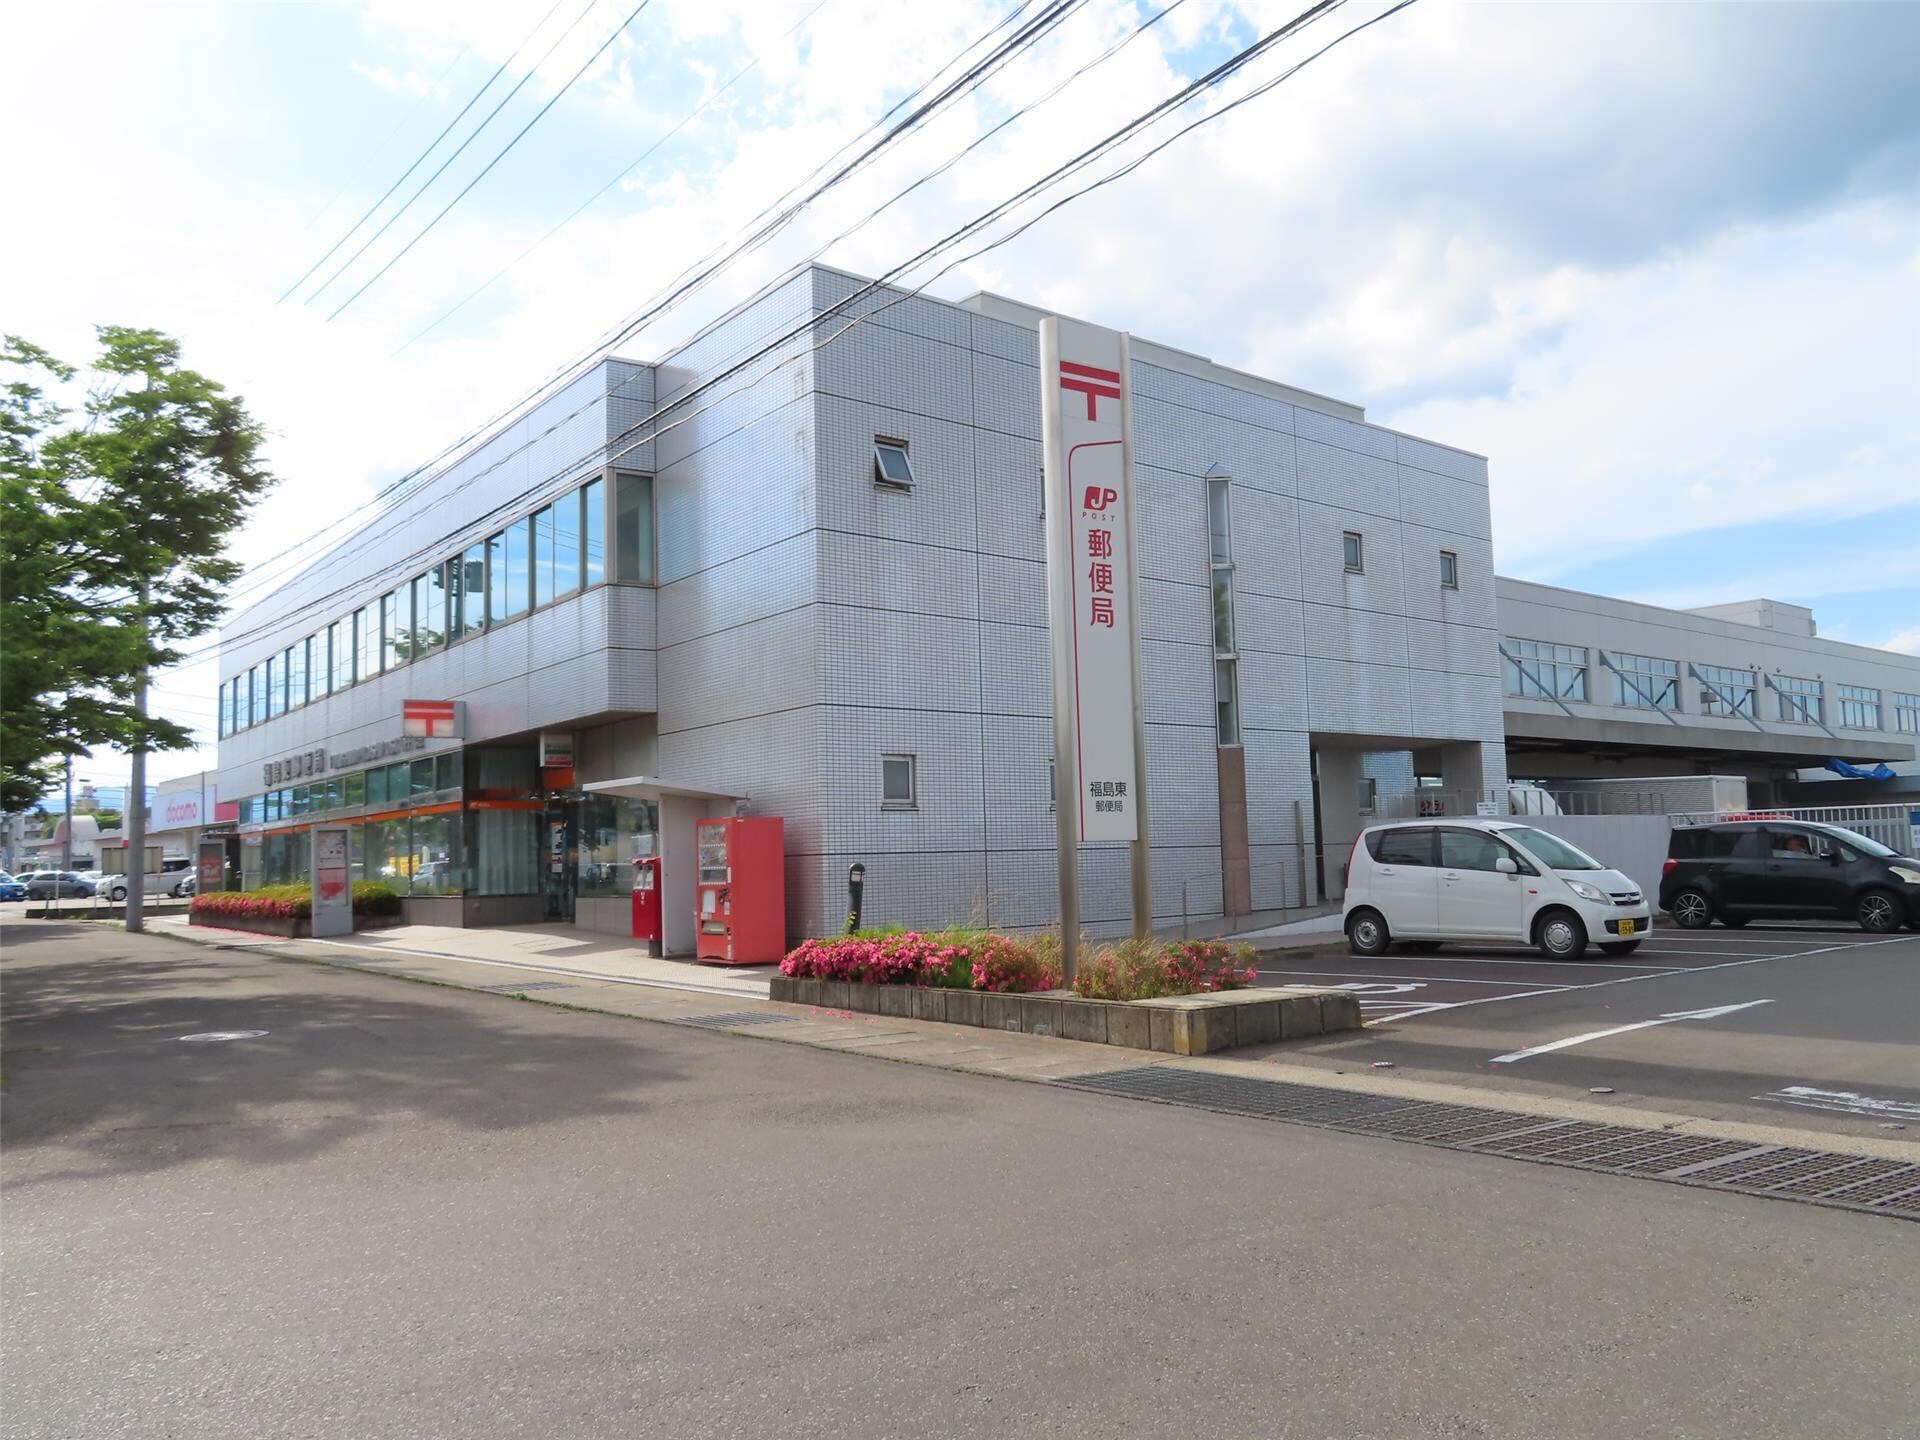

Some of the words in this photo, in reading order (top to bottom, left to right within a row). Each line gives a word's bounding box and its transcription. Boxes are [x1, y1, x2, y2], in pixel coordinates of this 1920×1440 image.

[1082, 511, 1115, 522] POST
[1088, 529, 1114, 628] 郵便局
[1090, 781, 1127, 797] 福島東
[166, 800, 197, 823] docomo
[1095, 800, 1123, 812] 郵便局
